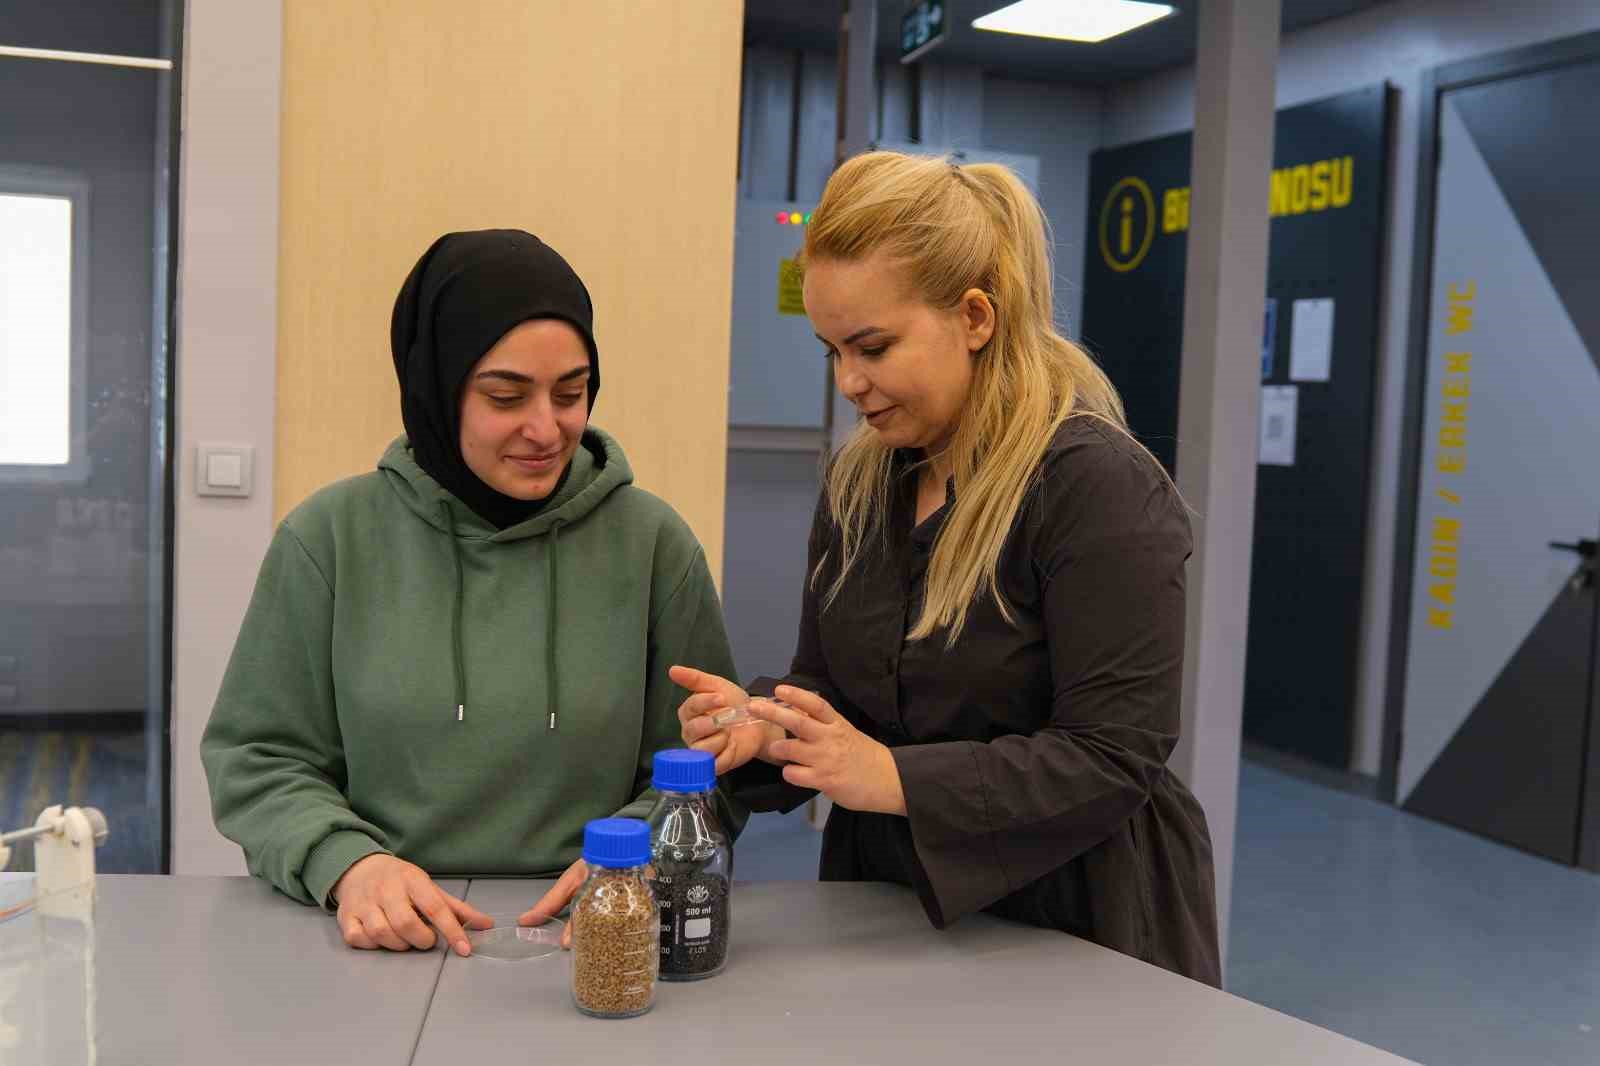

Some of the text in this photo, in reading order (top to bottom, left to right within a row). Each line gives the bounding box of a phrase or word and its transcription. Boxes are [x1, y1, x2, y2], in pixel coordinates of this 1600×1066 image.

[1267, 156, 1353, 217] NOSU
[1446, 281, 1476, 336] WC
[1437, 352, 1472, 474] ERKEK
[1427, 516, 1462, 630] KADIN
[685, 906, 711, 916] 500 ml
